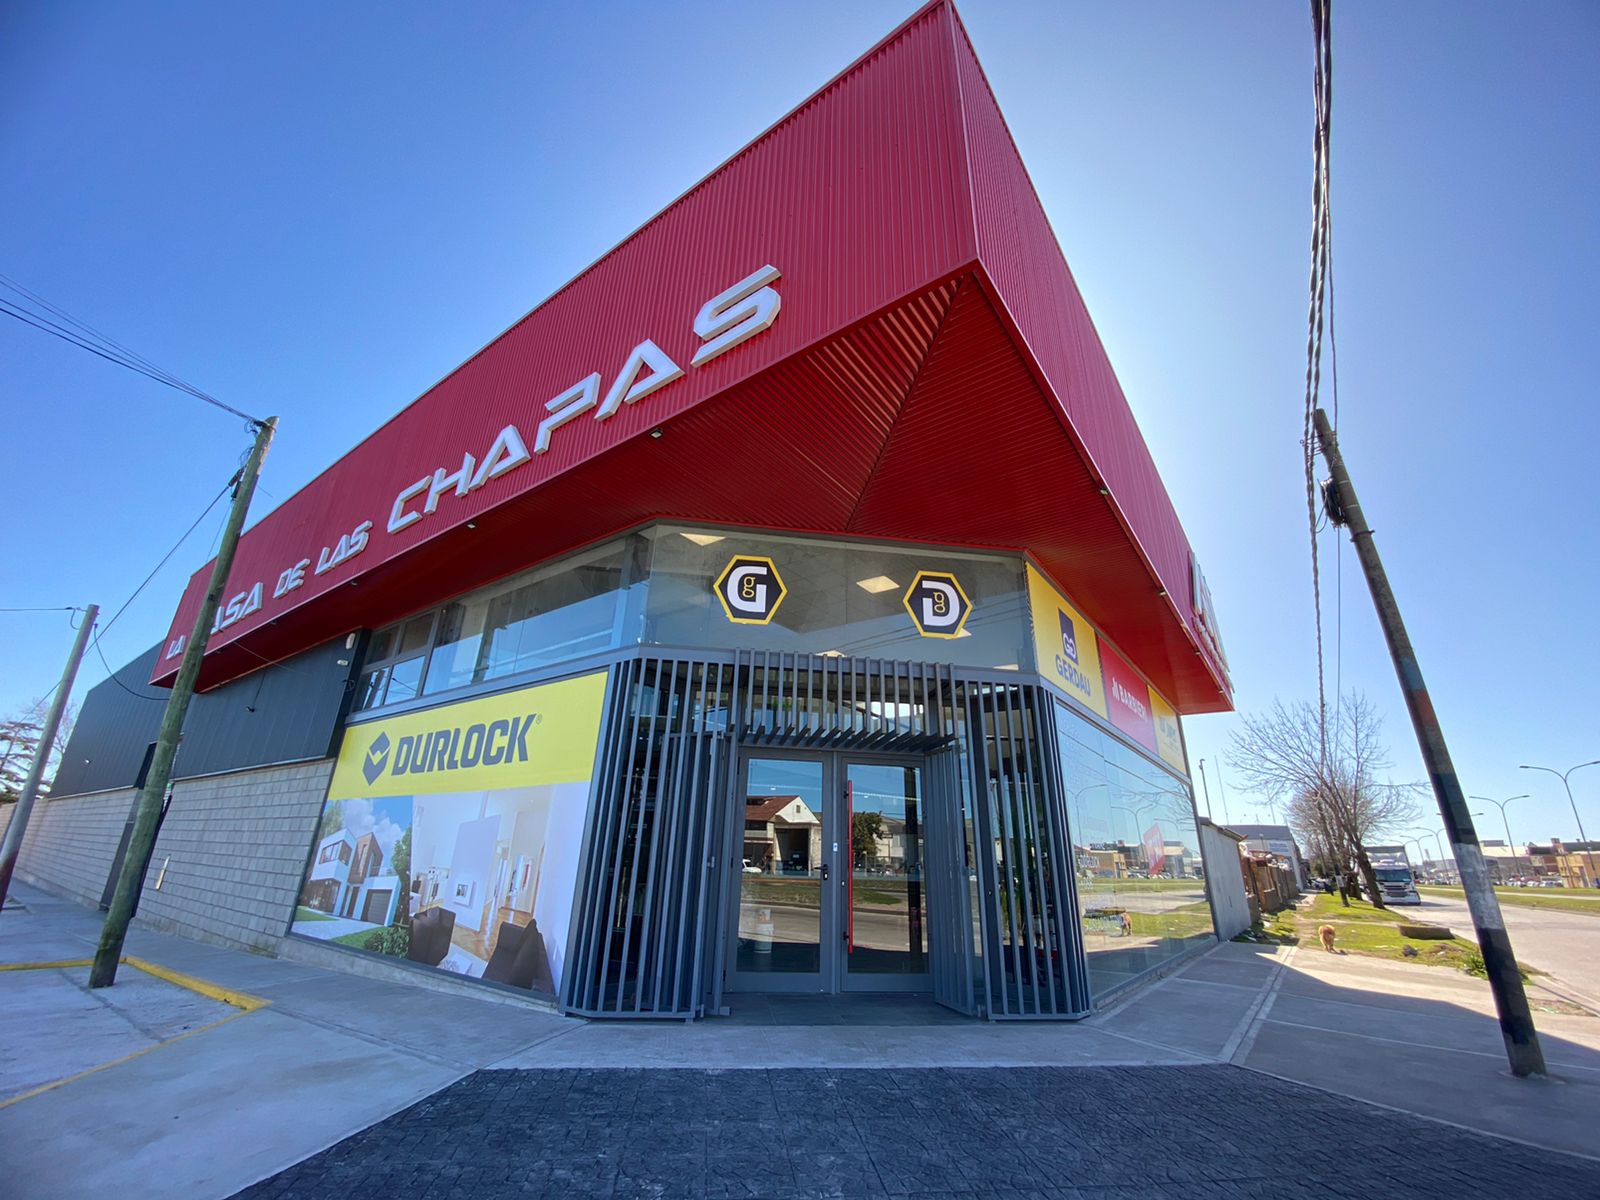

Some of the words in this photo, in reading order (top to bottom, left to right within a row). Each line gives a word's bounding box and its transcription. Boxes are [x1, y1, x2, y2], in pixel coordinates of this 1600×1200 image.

[166, 635, 185, 660] LA
[210, 582, 263, 635] ASA
[272, 558, 311, 599] DE
[314, 520, 373, 576] LAS
[387, 264, 782, 533] CHAPAS
[1055, 654, 1091, 697] GERDAU
[391, 713, 537, 776] DURLOCK
